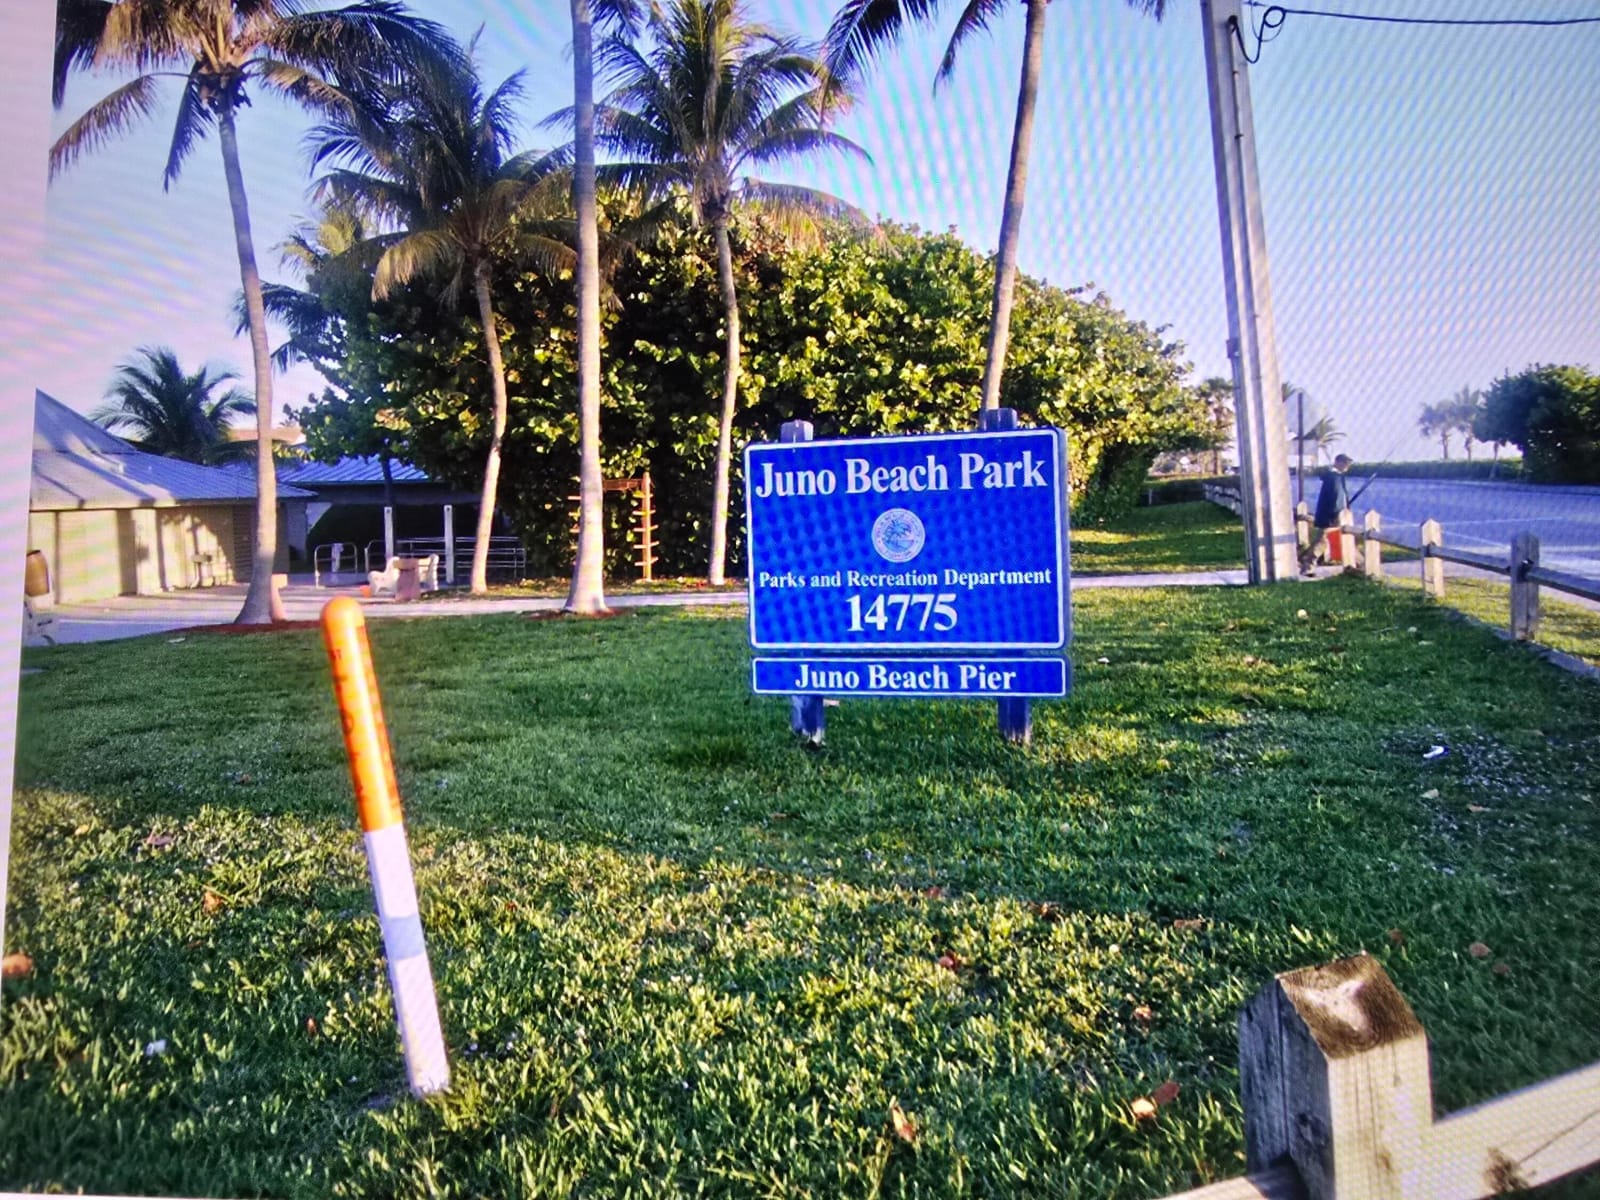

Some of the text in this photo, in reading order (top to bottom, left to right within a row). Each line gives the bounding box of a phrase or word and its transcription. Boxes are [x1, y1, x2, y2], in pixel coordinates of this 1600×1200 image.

[755, 450, 1048, 498] Juno Beach Park
[759, 568, 1051, 589] Parks and Recreation Department
[846, 593, 958, 632] 14775
[795, 664, 1016, 690] Juno Beach Pier
